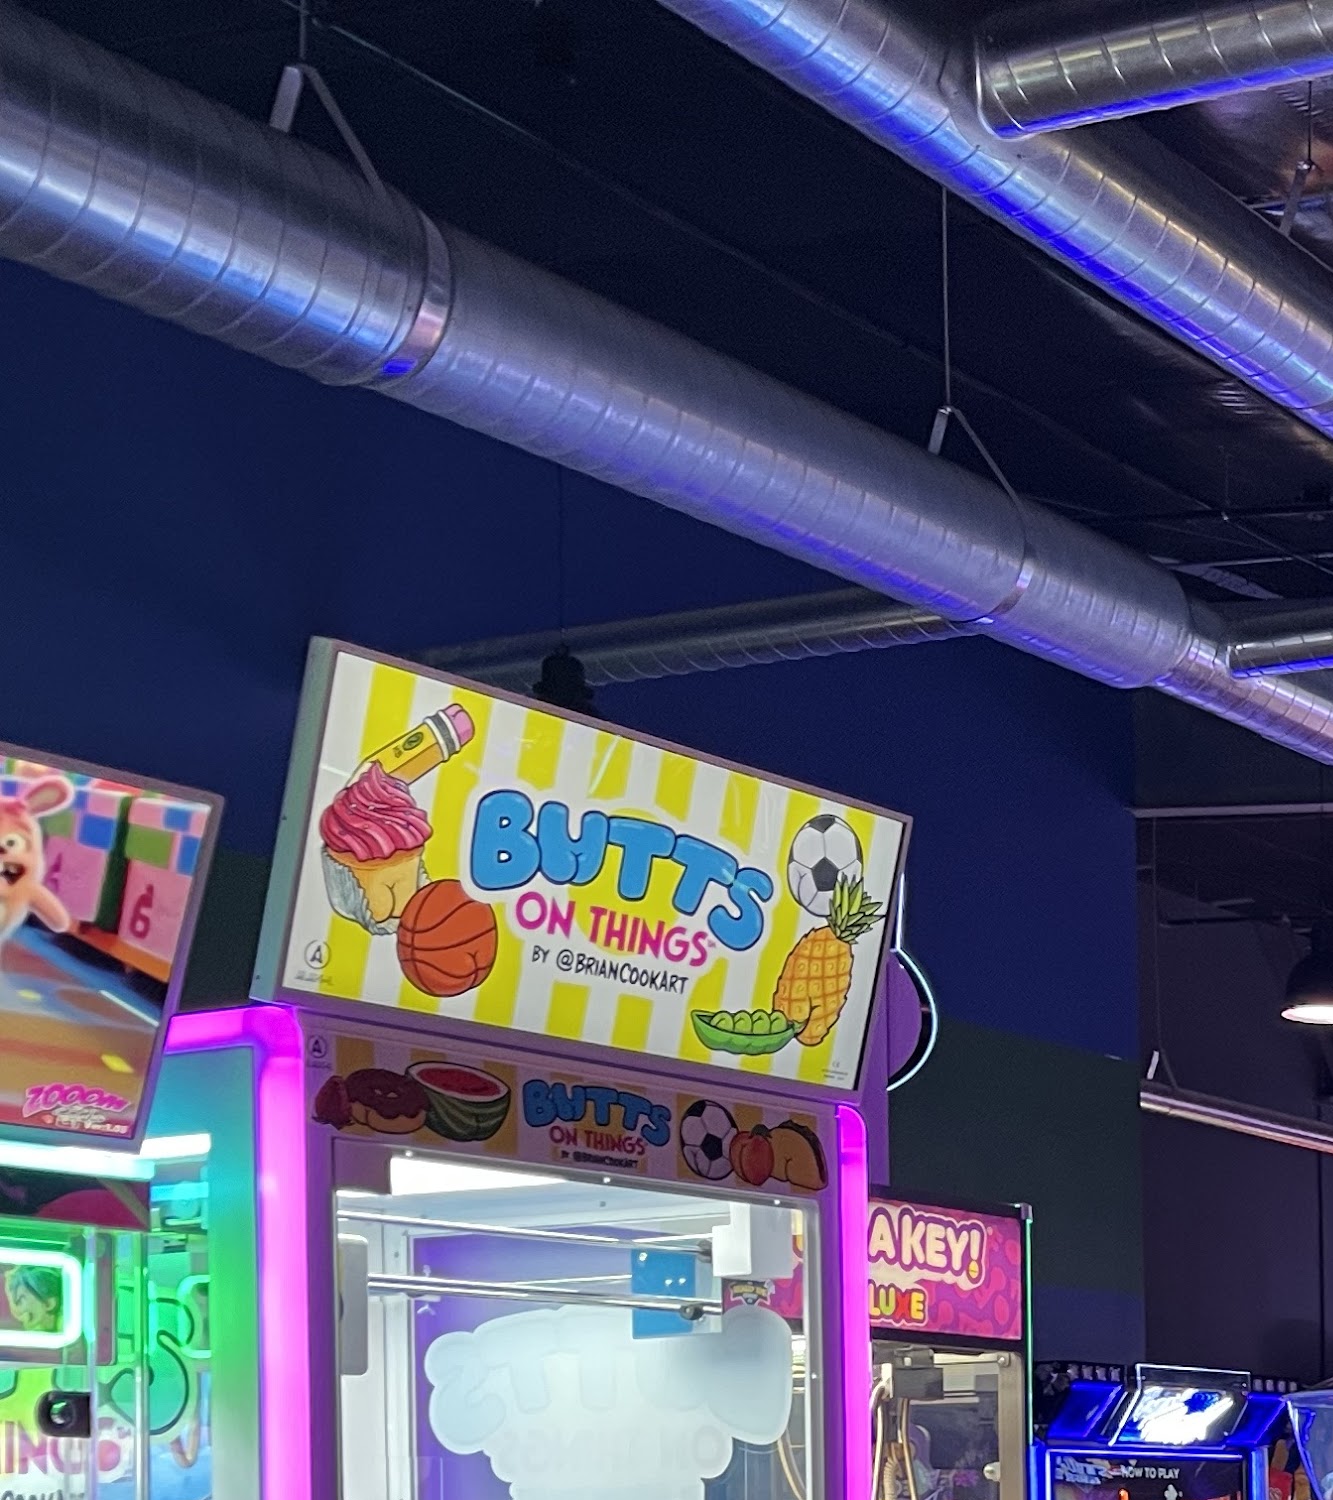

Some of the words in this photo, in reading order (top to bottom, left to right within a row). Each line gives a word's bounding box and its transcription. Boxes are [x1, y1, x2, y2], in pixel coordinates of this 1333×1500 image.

[470, 789, 774, 951] BUTTS
[515, 891, 576, 939] ON
[589, 905, 711, 967] THINGS
[532, 945, 550, 964] BY
[556, 949, 689, 995] @BRIANCOOKART
[522, 1079, 671, 1147] BUTTS
[550, 1125, 577, 1147] ON
[584, 1129, 646, 1156] THINGS
[901, 1214, 981, 1279] KEY!
[1144, 1468, 1157, 1479] TO
[1158, 1468, 1180, 1479] PLAY
